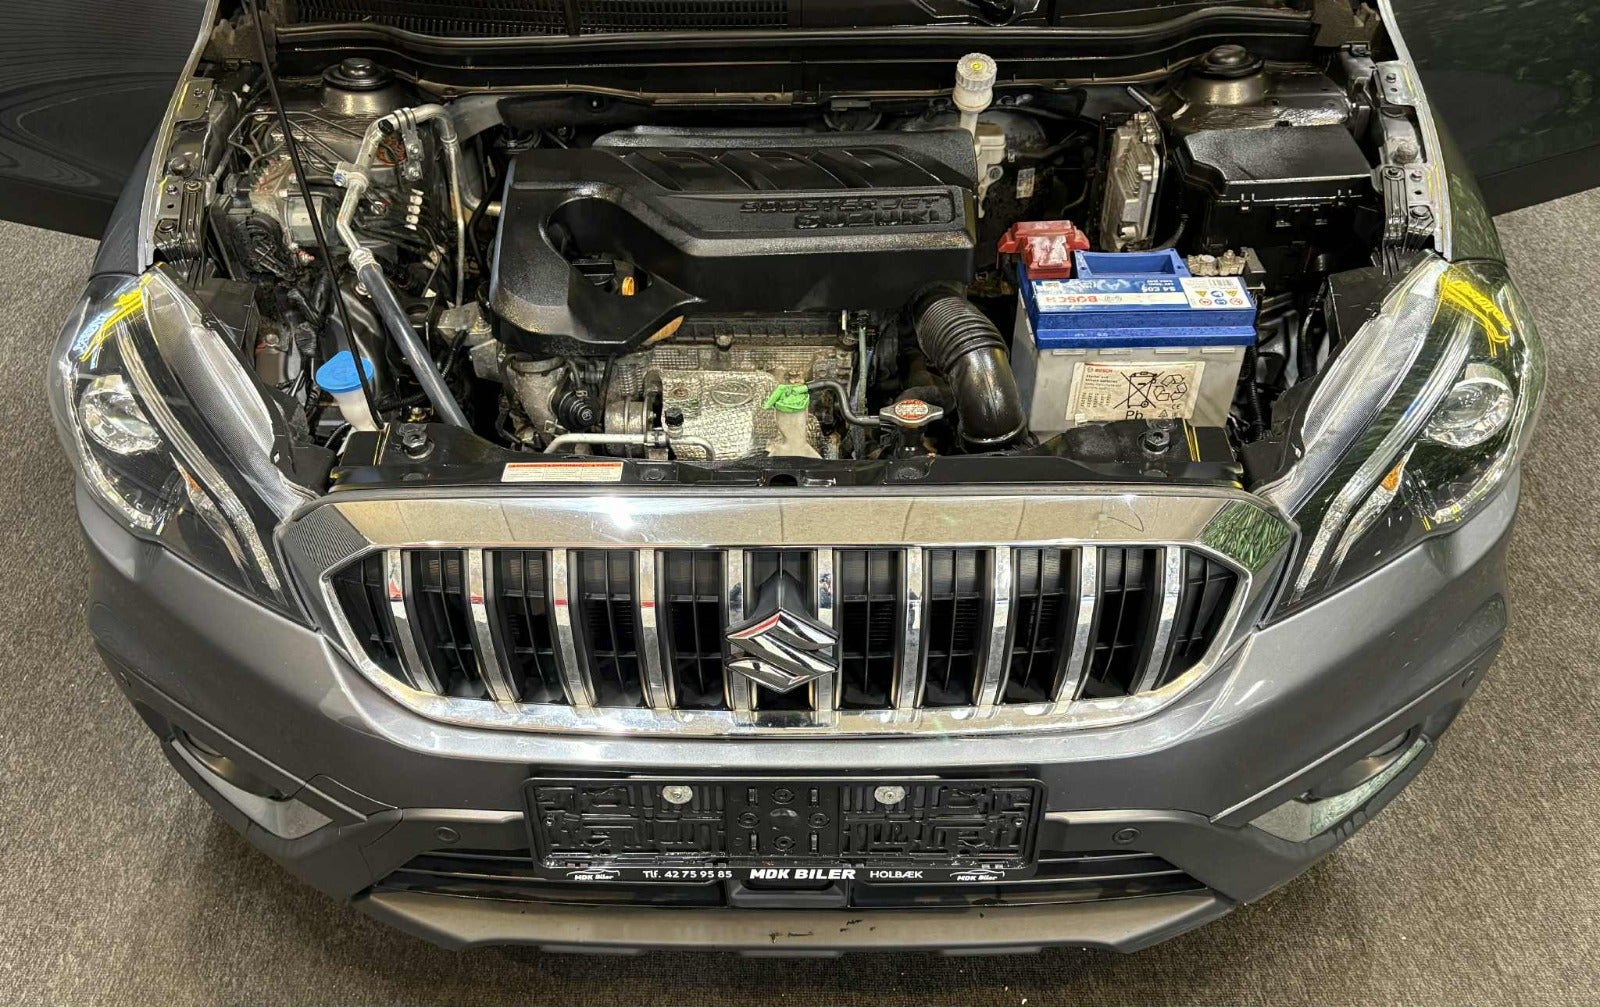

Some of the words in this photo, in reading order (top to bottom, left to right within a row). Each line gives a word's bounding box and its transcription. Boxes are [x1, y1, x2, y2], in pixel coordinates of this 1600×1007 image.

[794, 209, 940, 229] SUZUKI
[1046, 295, 1098, 303] BOSCH
[643, 870, 661, 879] Tlf.
[664, 870, 680, 879] 42
[681, 870, 697, 879] 75
[700, 870, 715, 879] 95
[717, 870, 733, 879] 85
[750, 868, 790, 880] MDK
[794, 868, 856, 880] BILER
[869, 870, 924, 879] HOLBÆK
